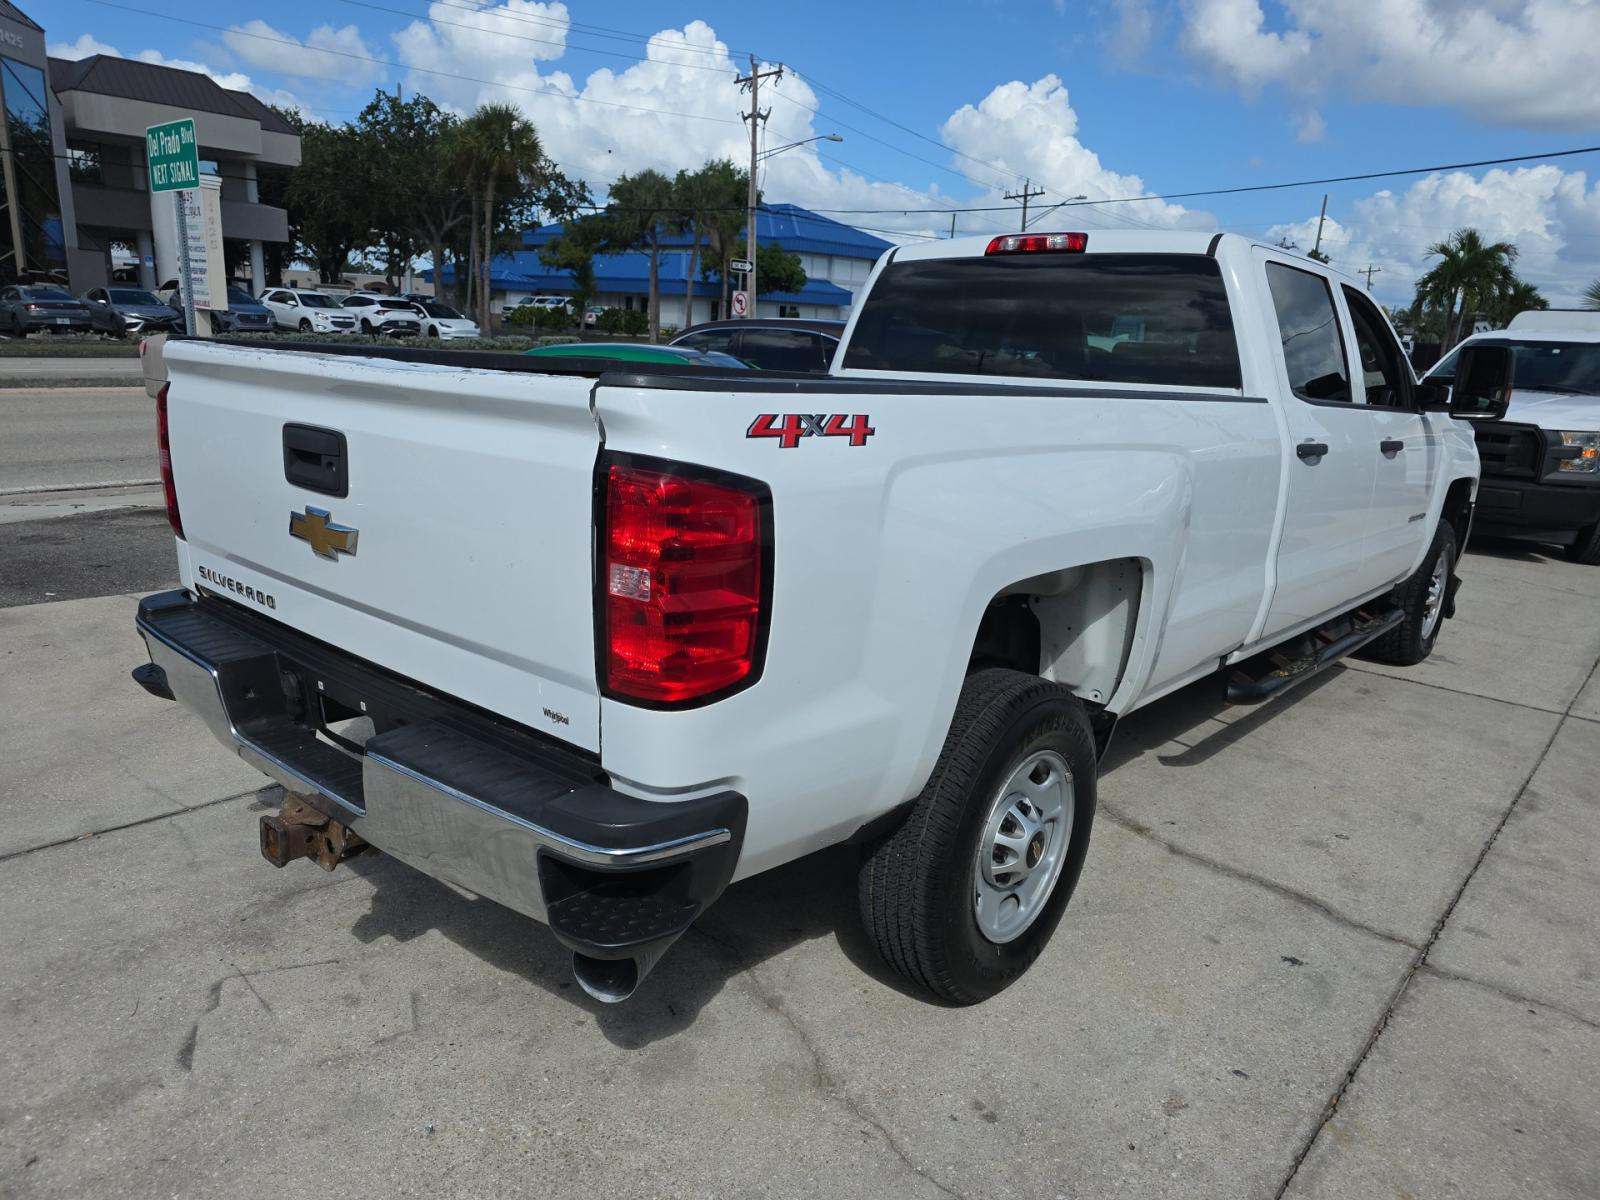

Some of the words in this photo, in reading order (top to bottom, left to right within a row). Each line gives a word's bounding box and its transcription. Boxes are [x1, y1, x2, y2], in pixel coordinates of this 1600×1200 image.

[148, 132, 160, 158] Del
[160, 129, 181, 155] Prado
[181, 124, 194, 144] Blvd
[153, 163, 169, 185] NEXT
[169, 160, 196, 183] SIGNAL
[198, 565, 277, 610] SILVERADO
